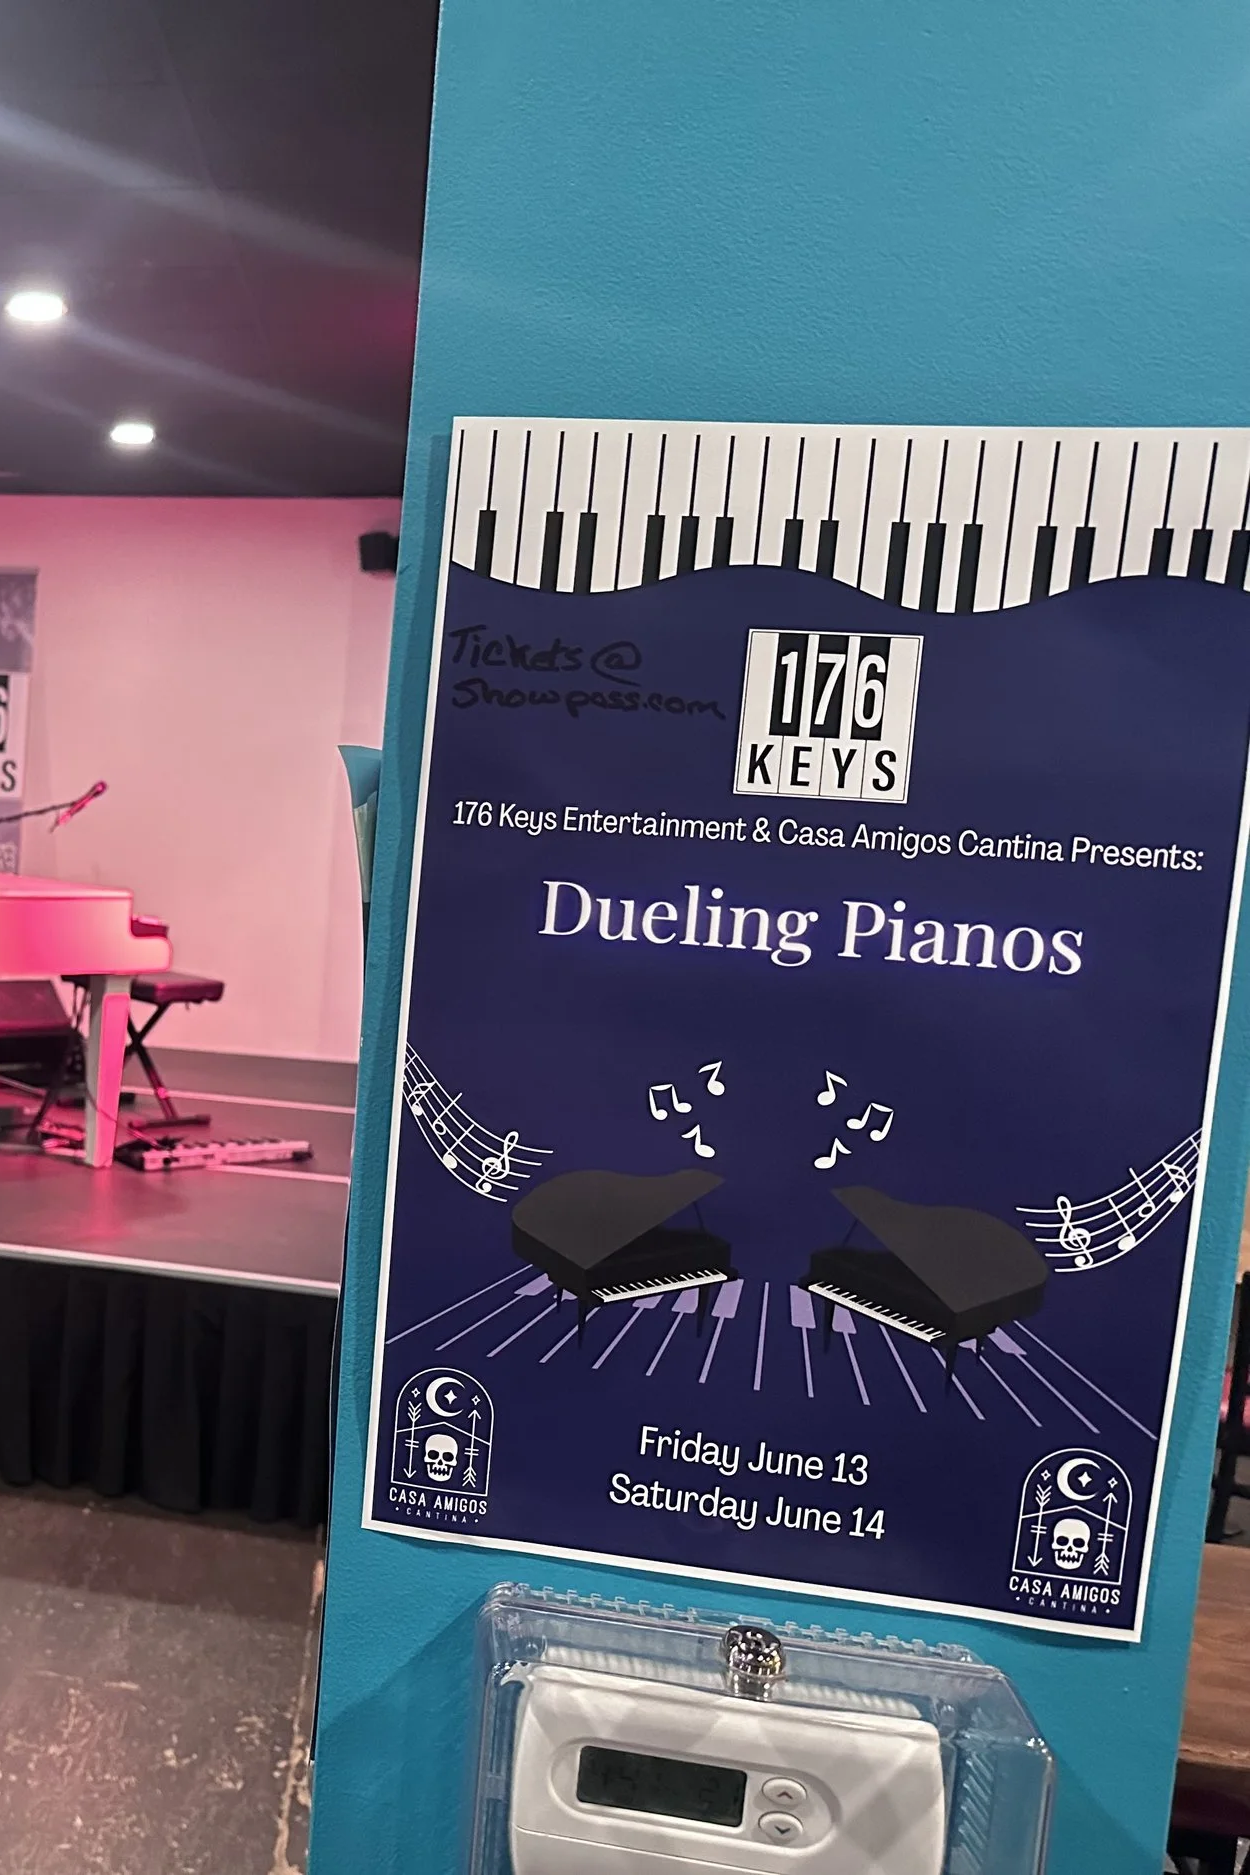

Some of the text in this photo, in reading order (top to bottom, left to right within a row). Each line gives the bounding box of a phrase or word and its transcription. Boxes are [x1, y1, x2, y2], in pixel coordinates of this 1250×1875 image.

[448, 624, 583, 672] Tickets
[779, 650, 887, 729] 176
[747, 742, 897, 792] KEYS
[452, 800, 1205, 872] 176 Keys Entertainment & Casa Amigos Cantina Presents:
[538, 880, 1085, 976] Dueling Pianos
[639, 1425, 870, 1486] Friday June 13
[388, 1486, 488, 1515] CASA AMIGOS
[406, 1507, 467, 1523] CANTINA
[608, 1473, 886, 1540] Saturday June 14
[1008, 1575, 1122, 1605] CASA AMIGOS
[1027, 1596, 1098, 1615] CANTINA
